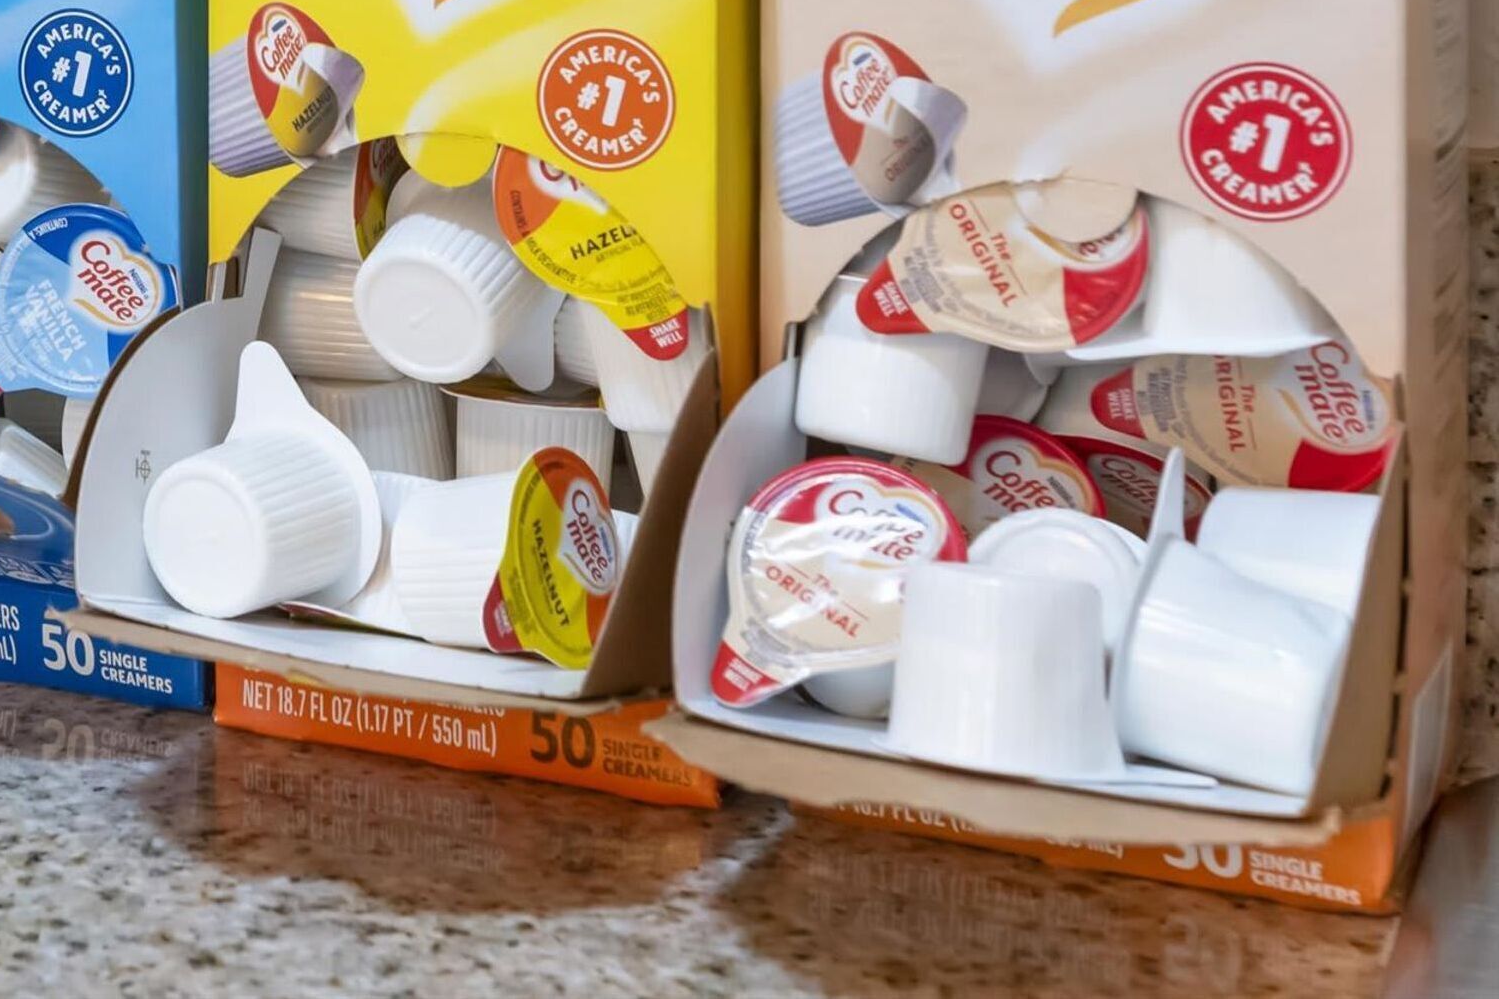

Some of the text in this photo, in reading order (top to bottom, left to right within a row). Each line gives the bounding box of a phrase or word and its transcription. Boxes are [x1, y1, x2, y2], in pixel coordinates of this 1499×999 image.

[36, 22, 122, 77] AMERICA'S
[51, 50, 93, 97] #1
[261, 25, 295, 73] Coffee
[559, 45, 660, 105] AMERICA'S
[576, 74, 626, 128] #1
[1205, 79, 1335, 148] AMERICA'S
[1228, 112, 1292, 174] #1
[80, 240, 144, 310] Coffee
[949, 203, 1017, 308] ORIGINAL
[24, 284, 75, 362] VANILLA
[37, 278, 87, 351] FRENCH
[77, 267, 133, 321] mate
[1214, 354, 1247, 453] RIGINAL
[1294, 363, 1344, 440] mate
[1309, 340, 1366, 435] Coffee
[572, 489, 609, 573] Coffee
[532, 519, 571, 627] HAZELNUT
[765, 564, 864, 639] ORIGNAL
[41, 623, 96, 676] 50
[99, 649, 148, 673] SINGLE
[101, 667, 173, 695] CREAMERS
[243, 678, 274, 712] NET
[276, 685, 307, 719] 18.7
[309, 692, 328, 722] FL
[331, 696, 353, 728] OZ
[356, 697, 390, 733] (1.17
[393, 707, 414, 738] PT
[431, 713, 463, 748] 550
[467, 720, 498, 758] mL)
[530, 710, 596, 769] 50
[602, 758, 693, 787] CREAMERS
[603, 738, 663, 762] SINGLE
[1249, 851, 1323, 882] SINGLE
[1251, 869, 1362, 906] CREAMERS
